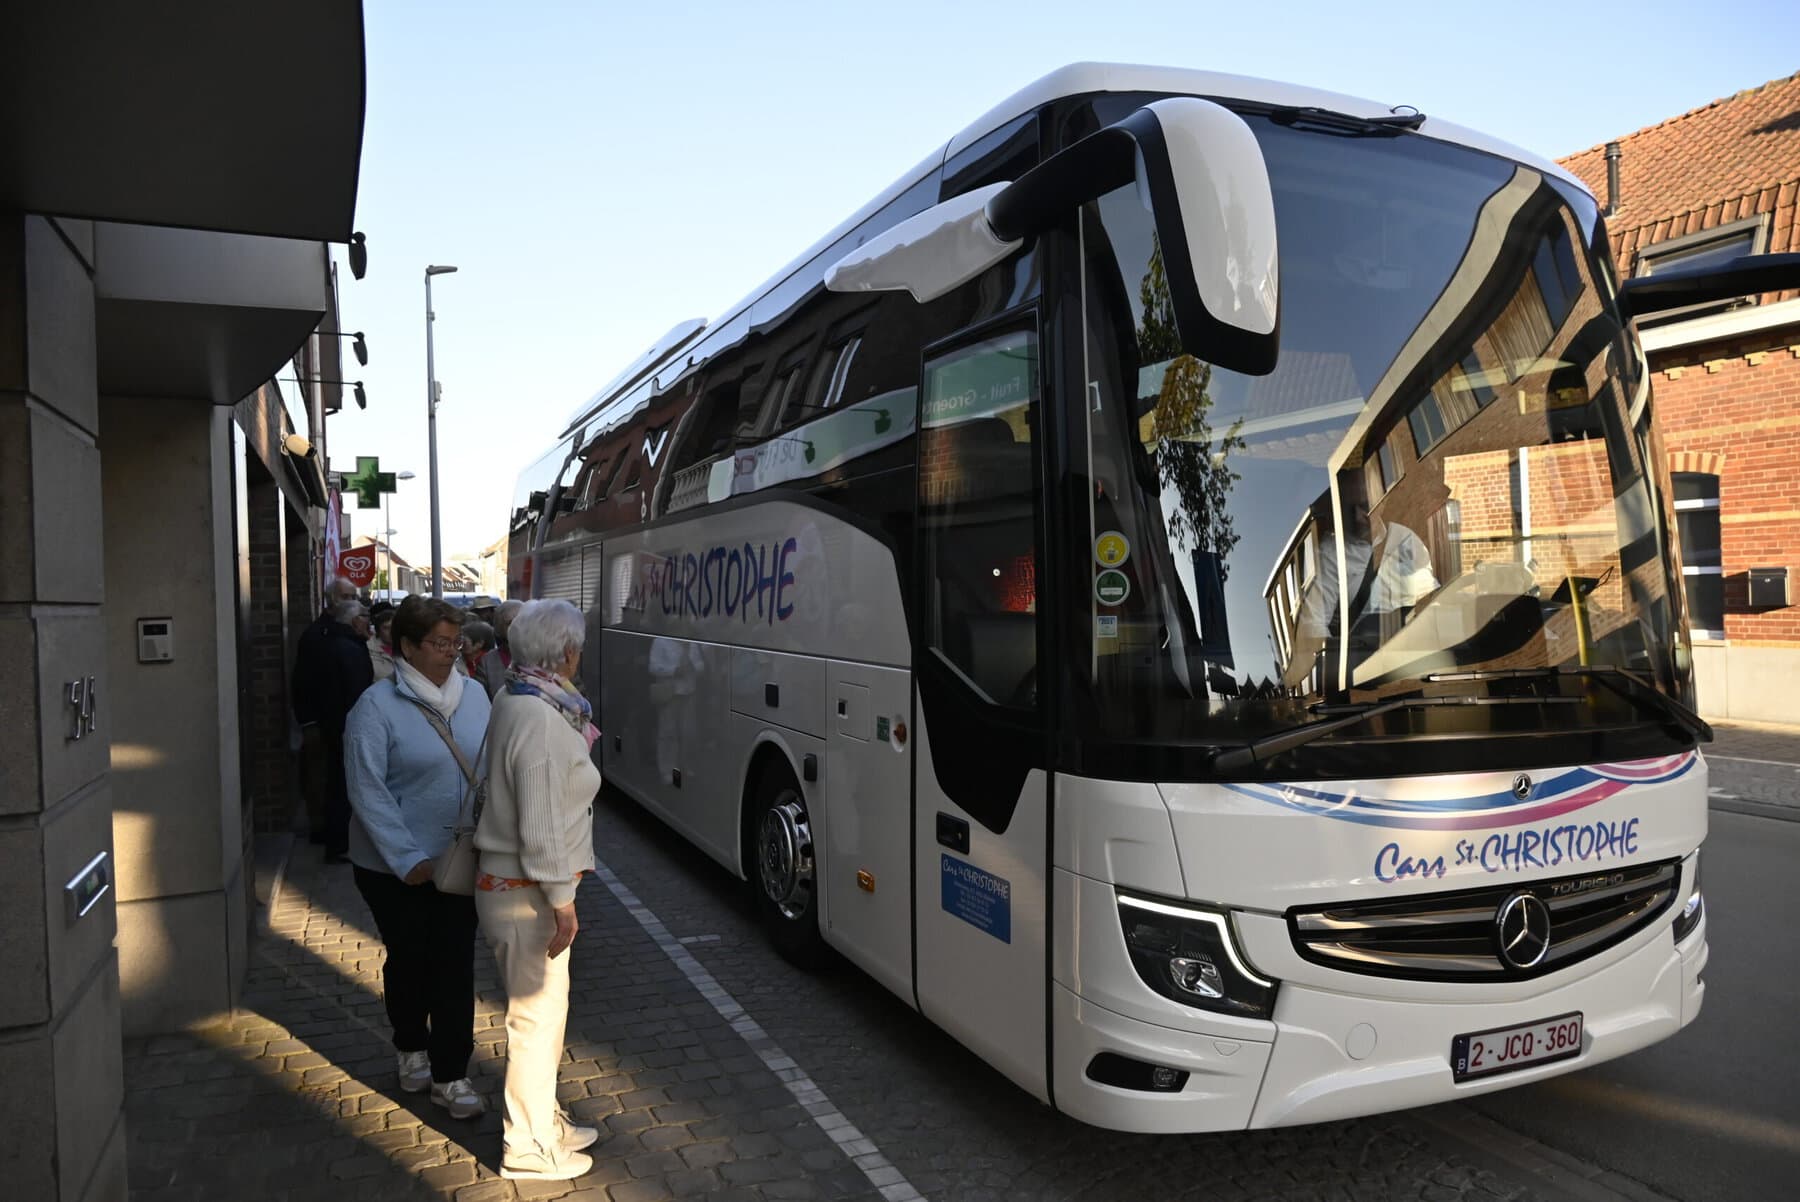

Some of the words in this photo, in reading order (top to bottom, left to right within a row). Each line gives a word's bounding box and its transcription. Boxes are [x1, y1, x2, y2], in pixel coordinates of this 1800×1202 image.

[661, 537, 797, 627] CHRISTOPHE
[1374, 842, 1447, 884] Cars
[1479, 817, 1639, 873] CHRISTOPHE
[1457, 1058, 1467, 1070] B
